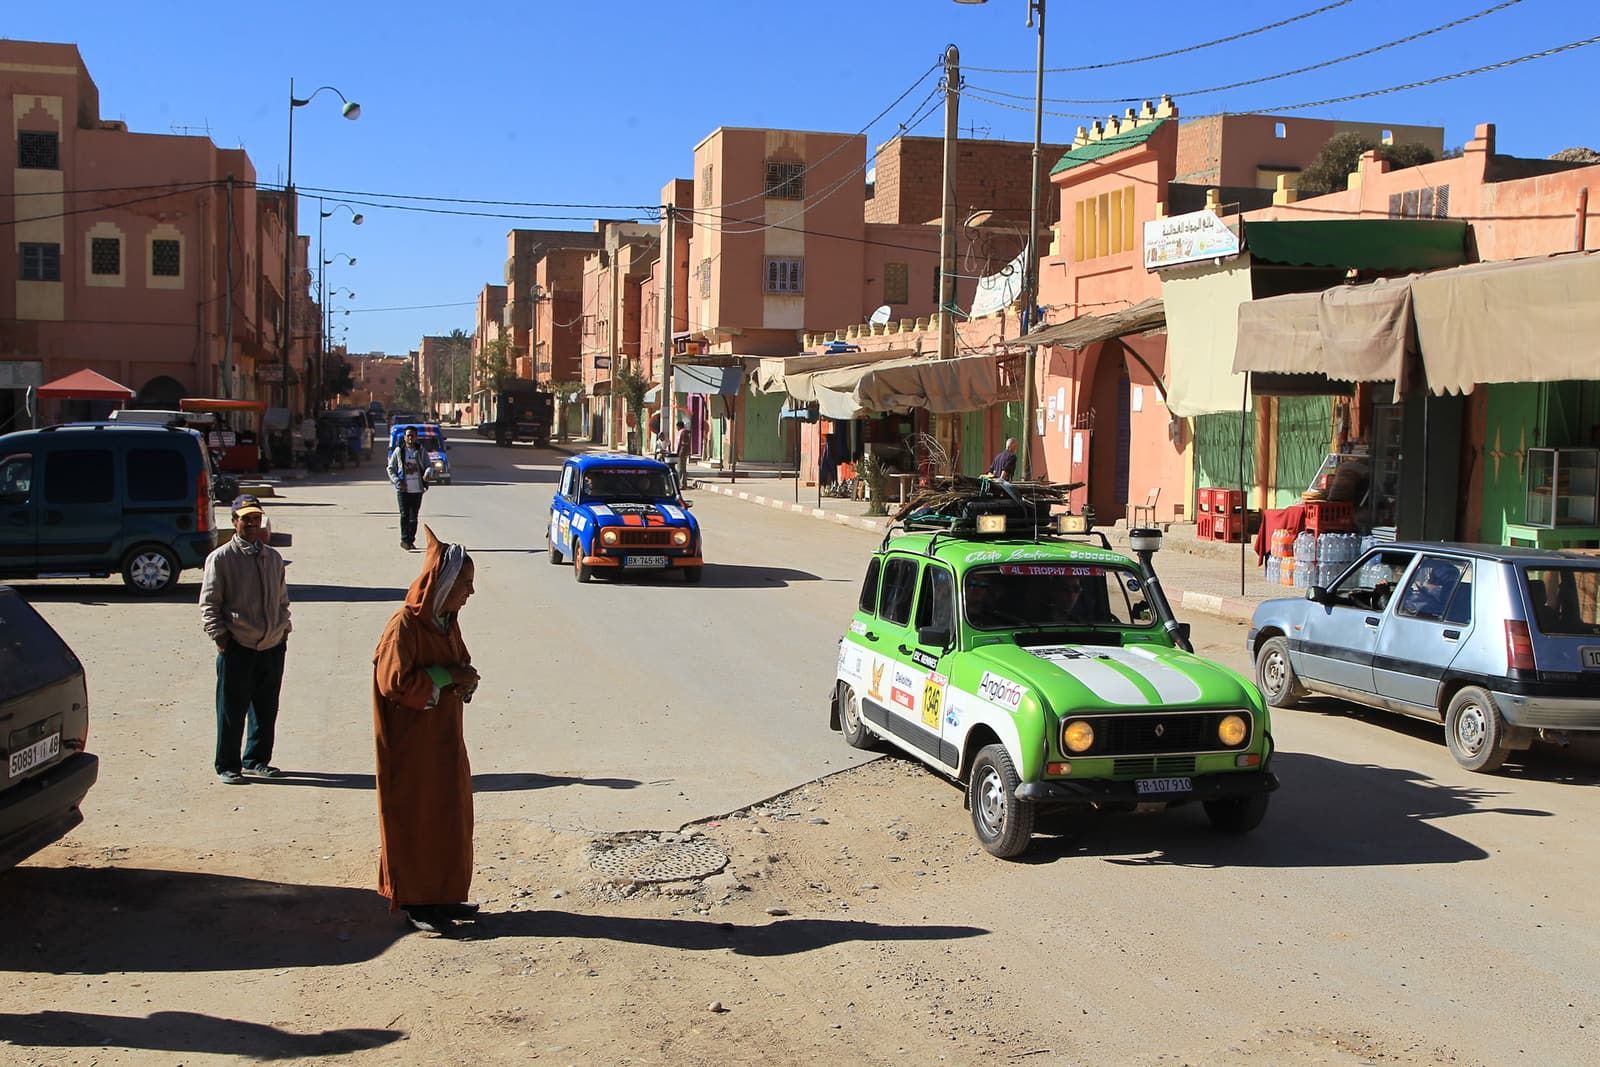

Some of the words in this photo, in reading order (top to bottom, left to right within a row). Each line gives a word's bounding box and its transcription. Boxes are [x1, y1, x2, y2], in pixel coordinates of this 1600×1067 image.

[1028, 566, 1066, 575] TROPHY
[1071, 567, 1091, 576] 2015
[924, 685, 941, 716] 1346
[980, 672, 1022, 706] Angloinfo
[11, 748, 37, 773] 50891
